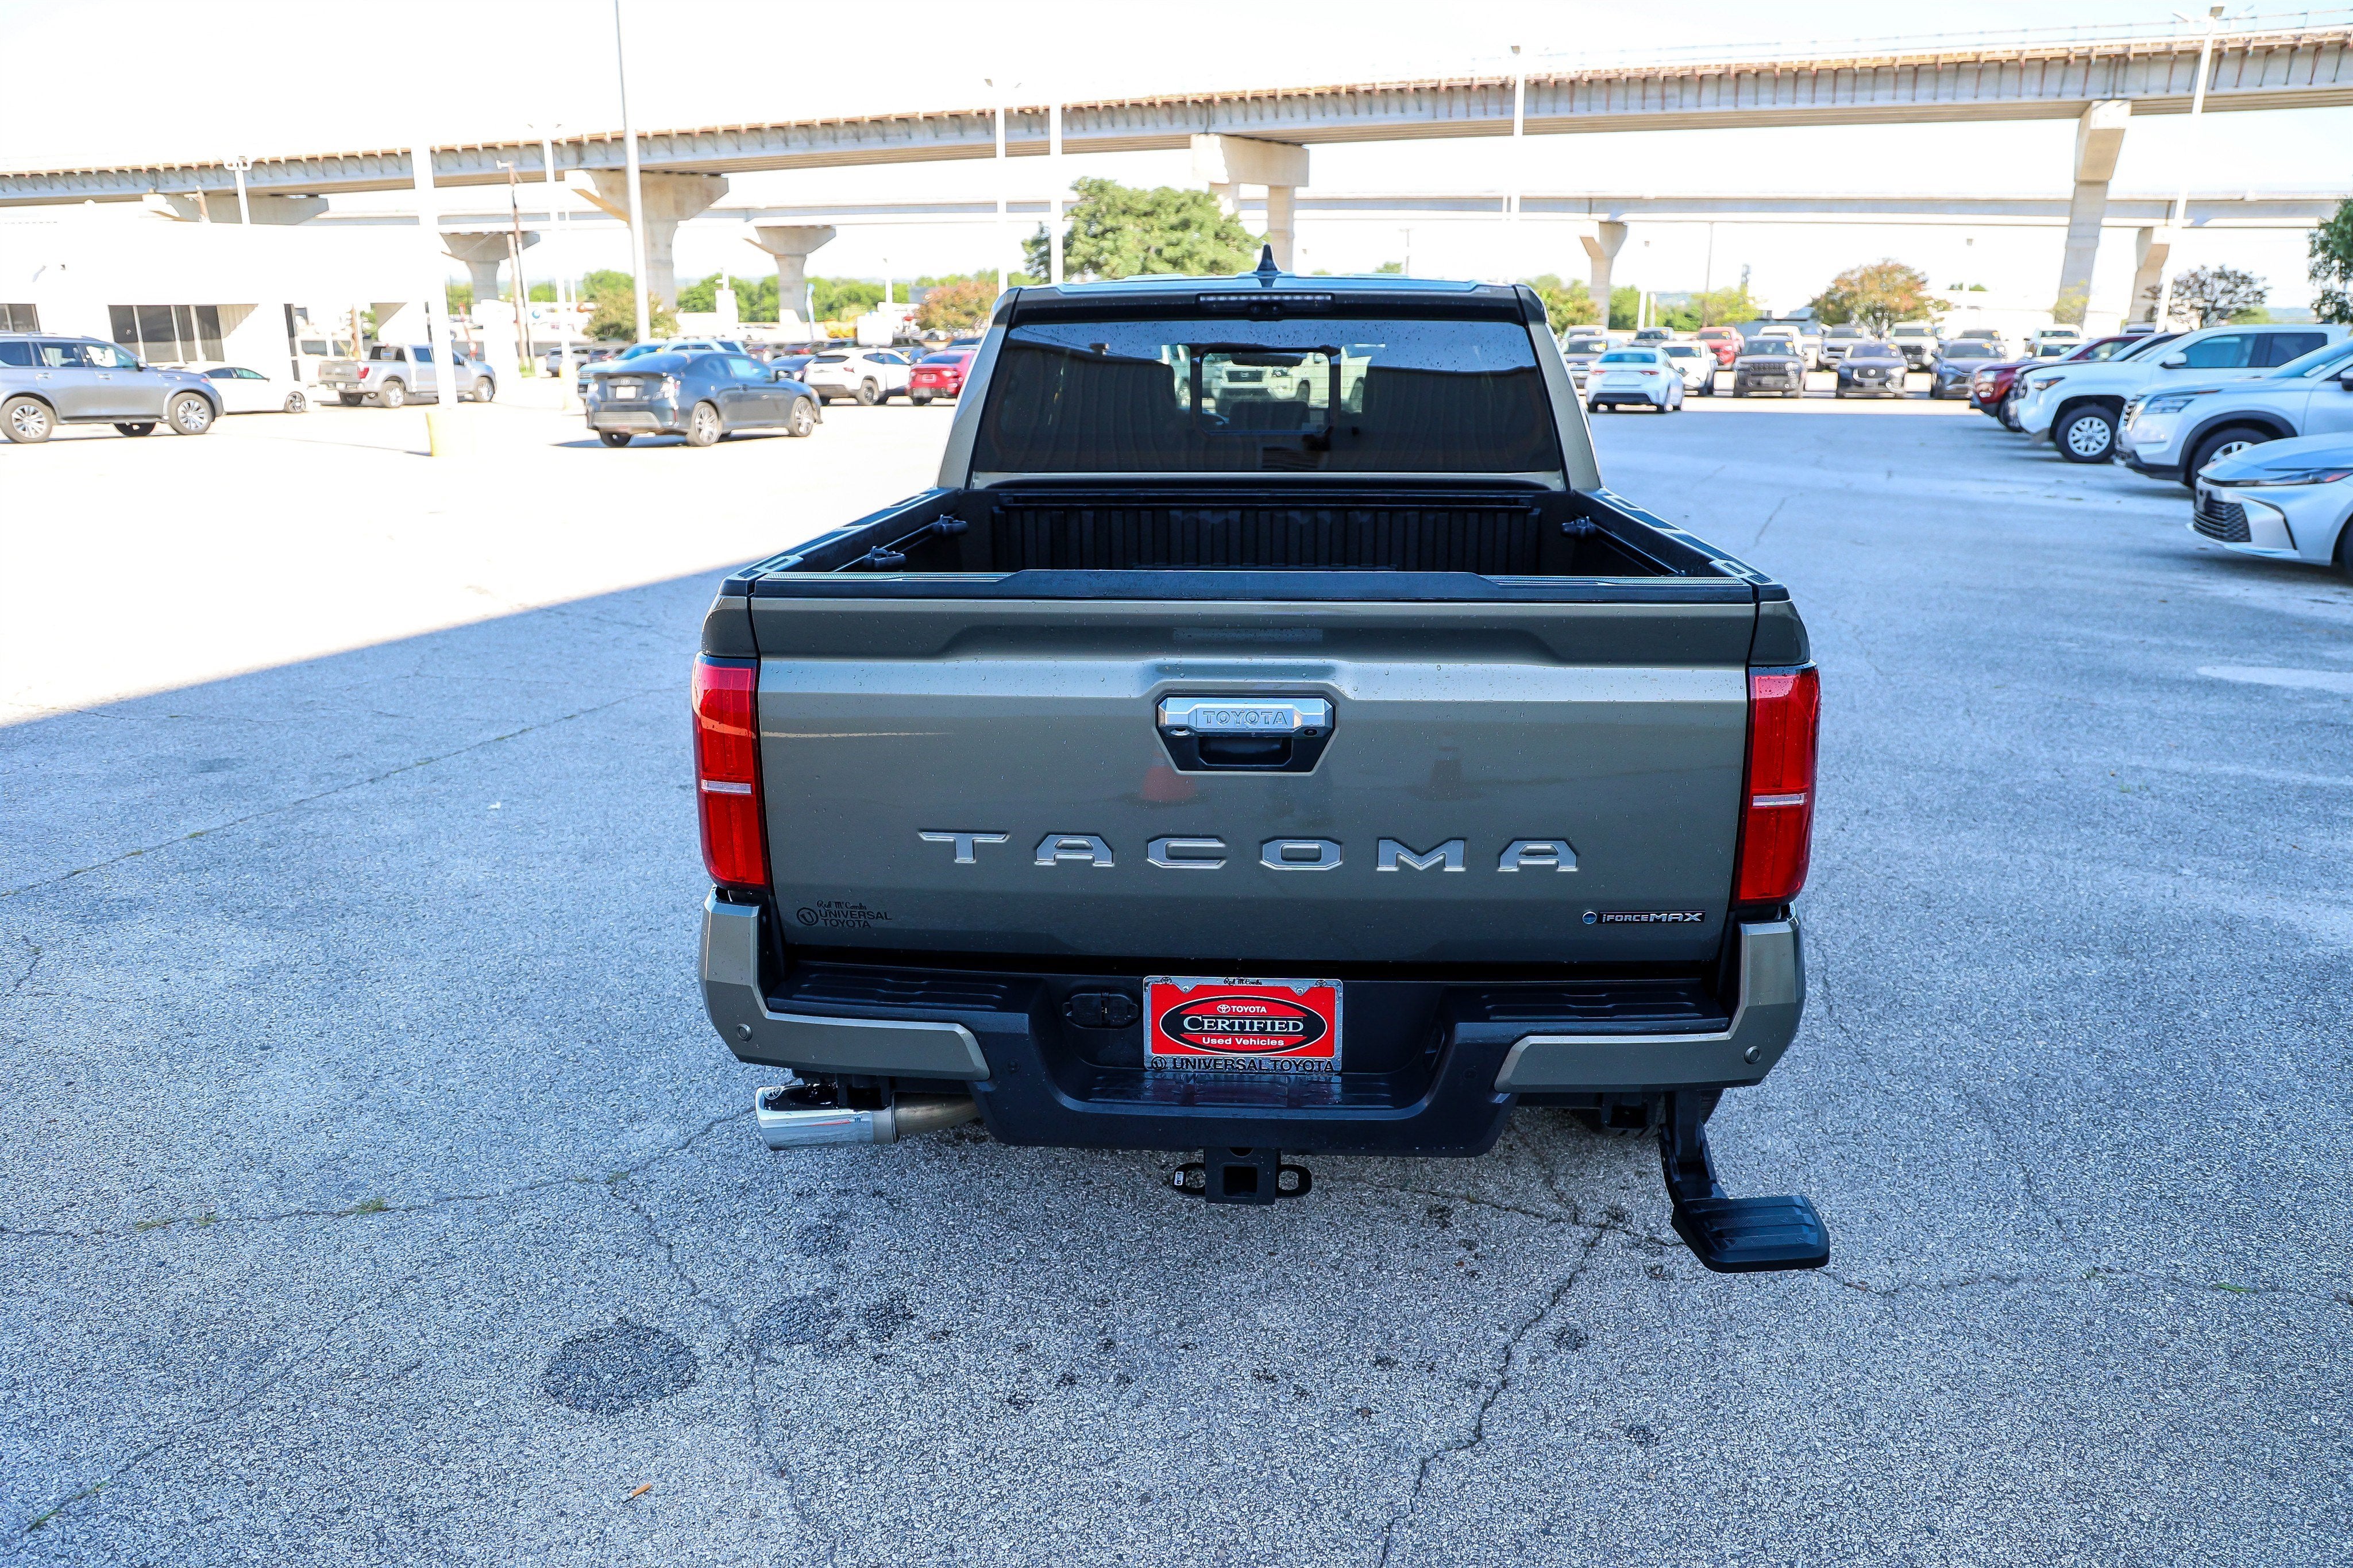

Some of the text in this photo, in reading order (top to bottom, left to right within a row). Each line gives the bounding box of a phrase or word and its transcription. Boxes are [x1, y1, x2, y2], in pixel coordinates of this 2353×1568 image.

[1203, 710, 1288, 725] TOYOTA
[917, 831, 1579, 872] TACOMA
[819, 910, 892, 920] UNIVERSAL
[821, 919, 872, 928] TOYOTA
[1231, 1005, 1267, 1013] TOYOTA
[1202, 1037, 1284, 1046] Used Vehicles
[1172, 1057, 1268, 1072] UNIVERSAL
[1270, 1059, 1334, 1072] TOYOTA
